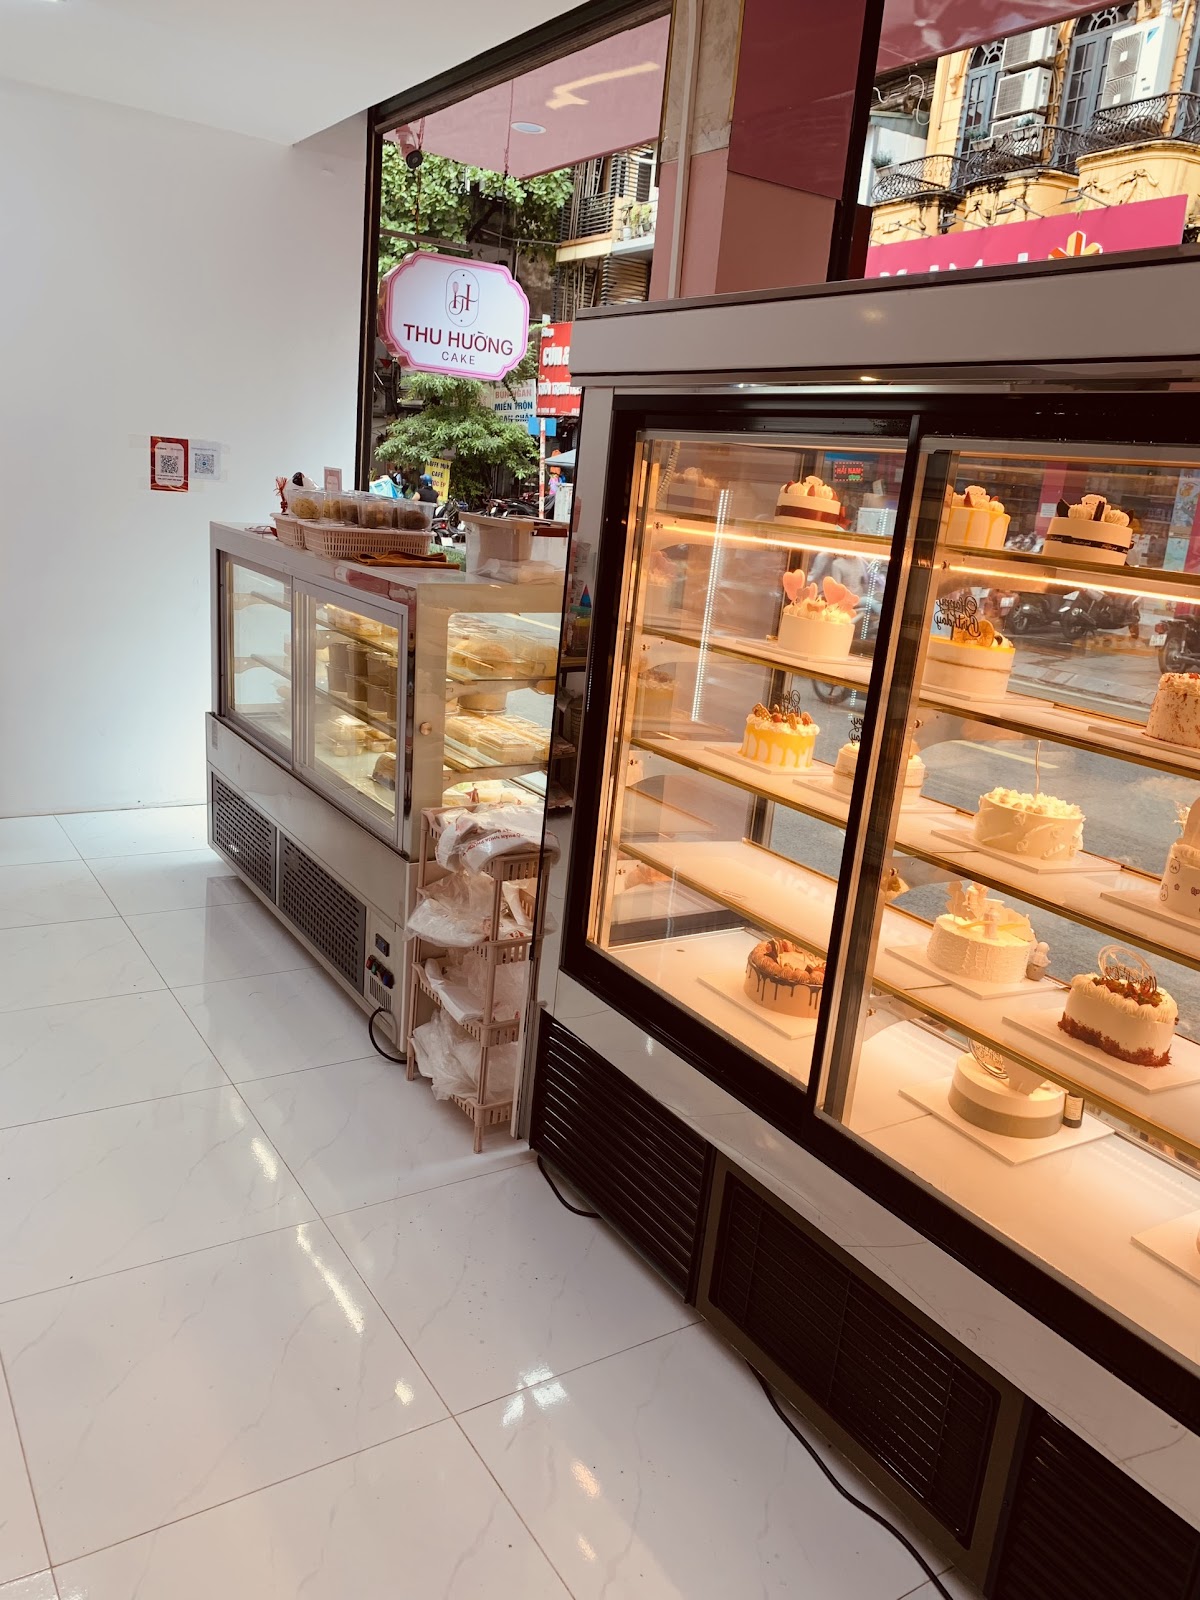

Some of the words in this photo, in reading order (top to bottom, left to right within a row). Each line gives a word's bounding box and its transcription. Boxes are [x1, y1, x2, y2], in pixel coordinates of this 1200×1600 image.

[403, 324, 442, 345] THU
[448, 331, 513, 356] HƯỜNG
[441, 351, 475, 365] CAKE
